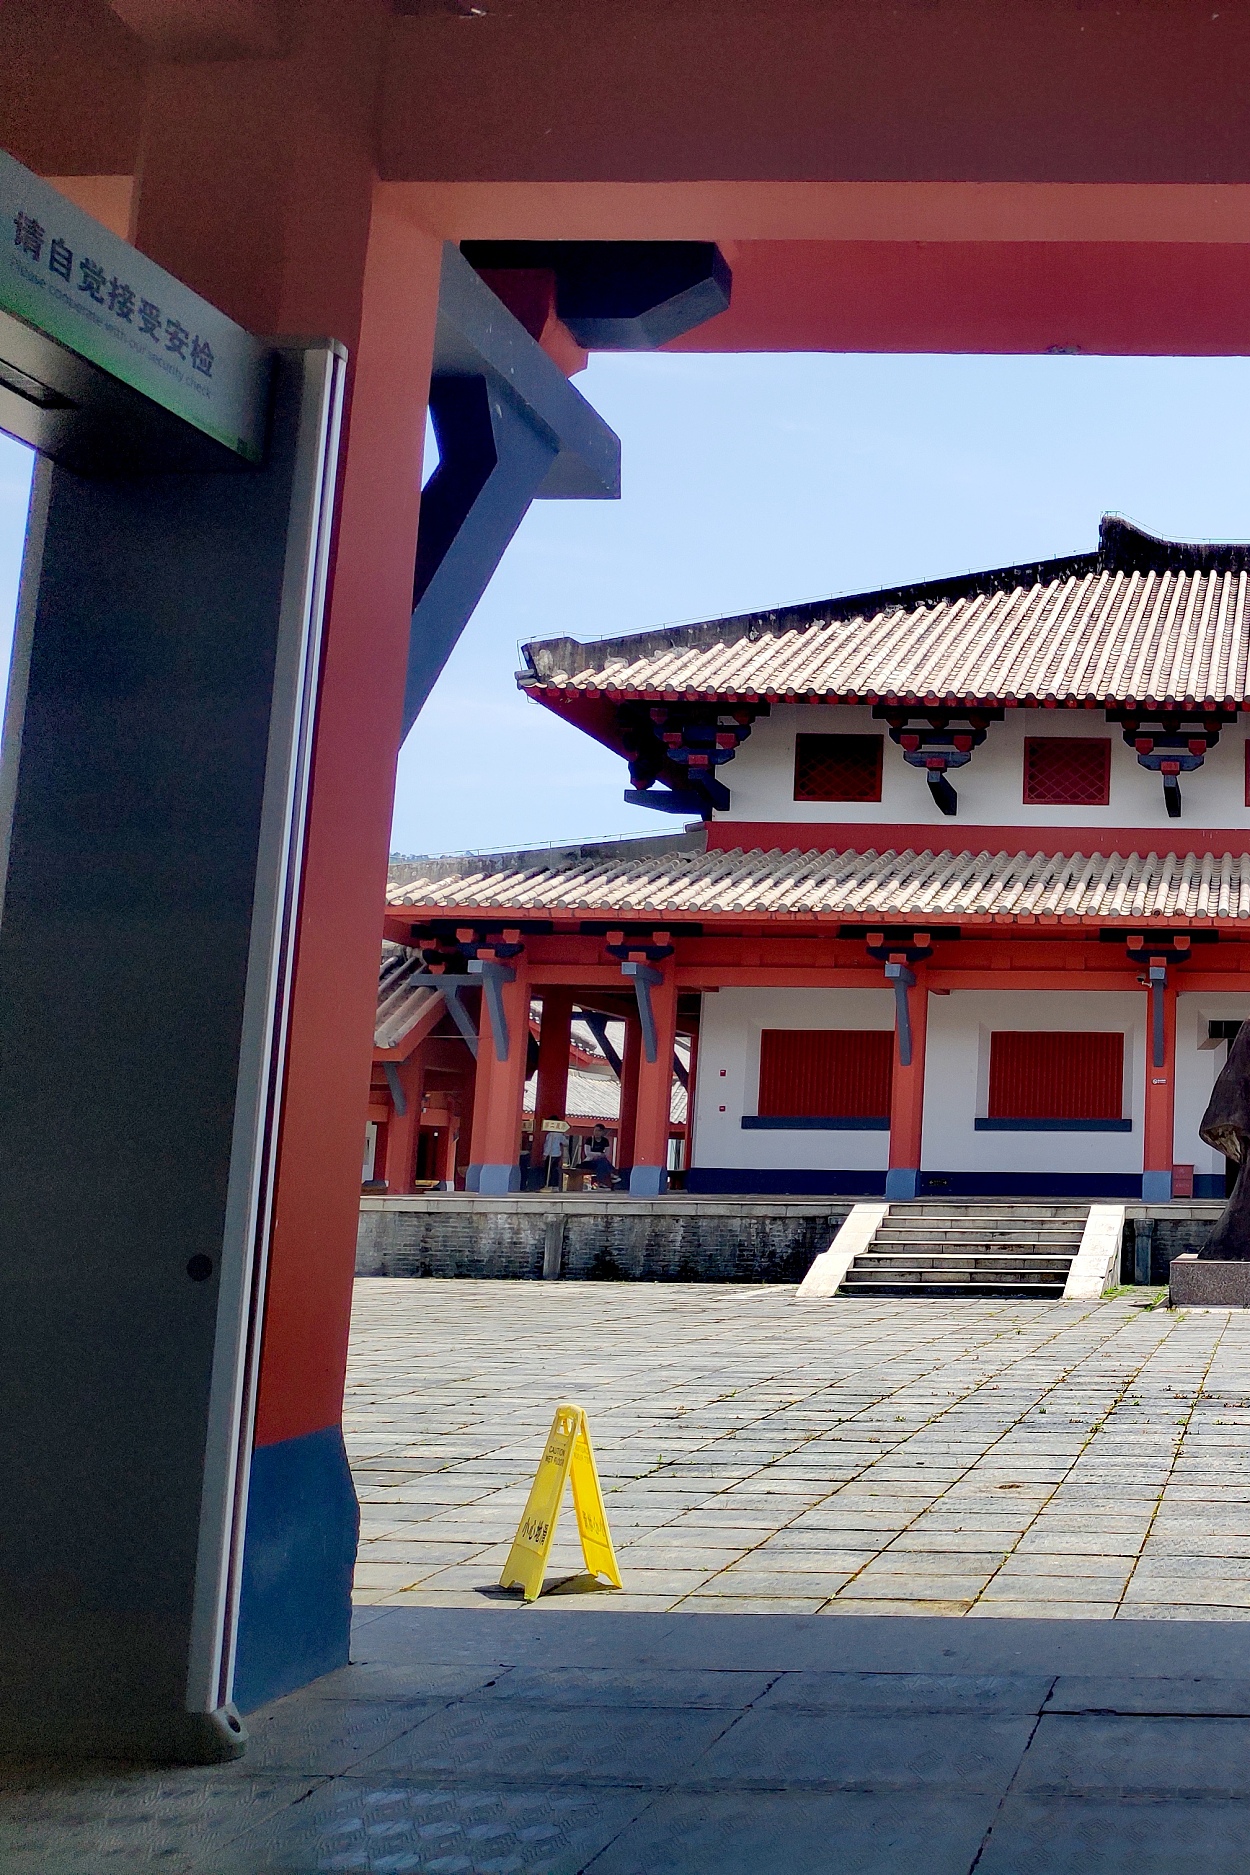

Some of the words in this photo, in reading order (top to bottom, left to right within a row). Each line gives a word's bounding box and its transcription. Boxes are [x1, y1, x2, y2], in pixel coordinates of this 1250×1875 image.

[13, 211, 214, 377] 请自觉接受安检
[522, 1517, 549, 1545] 小心地滑
